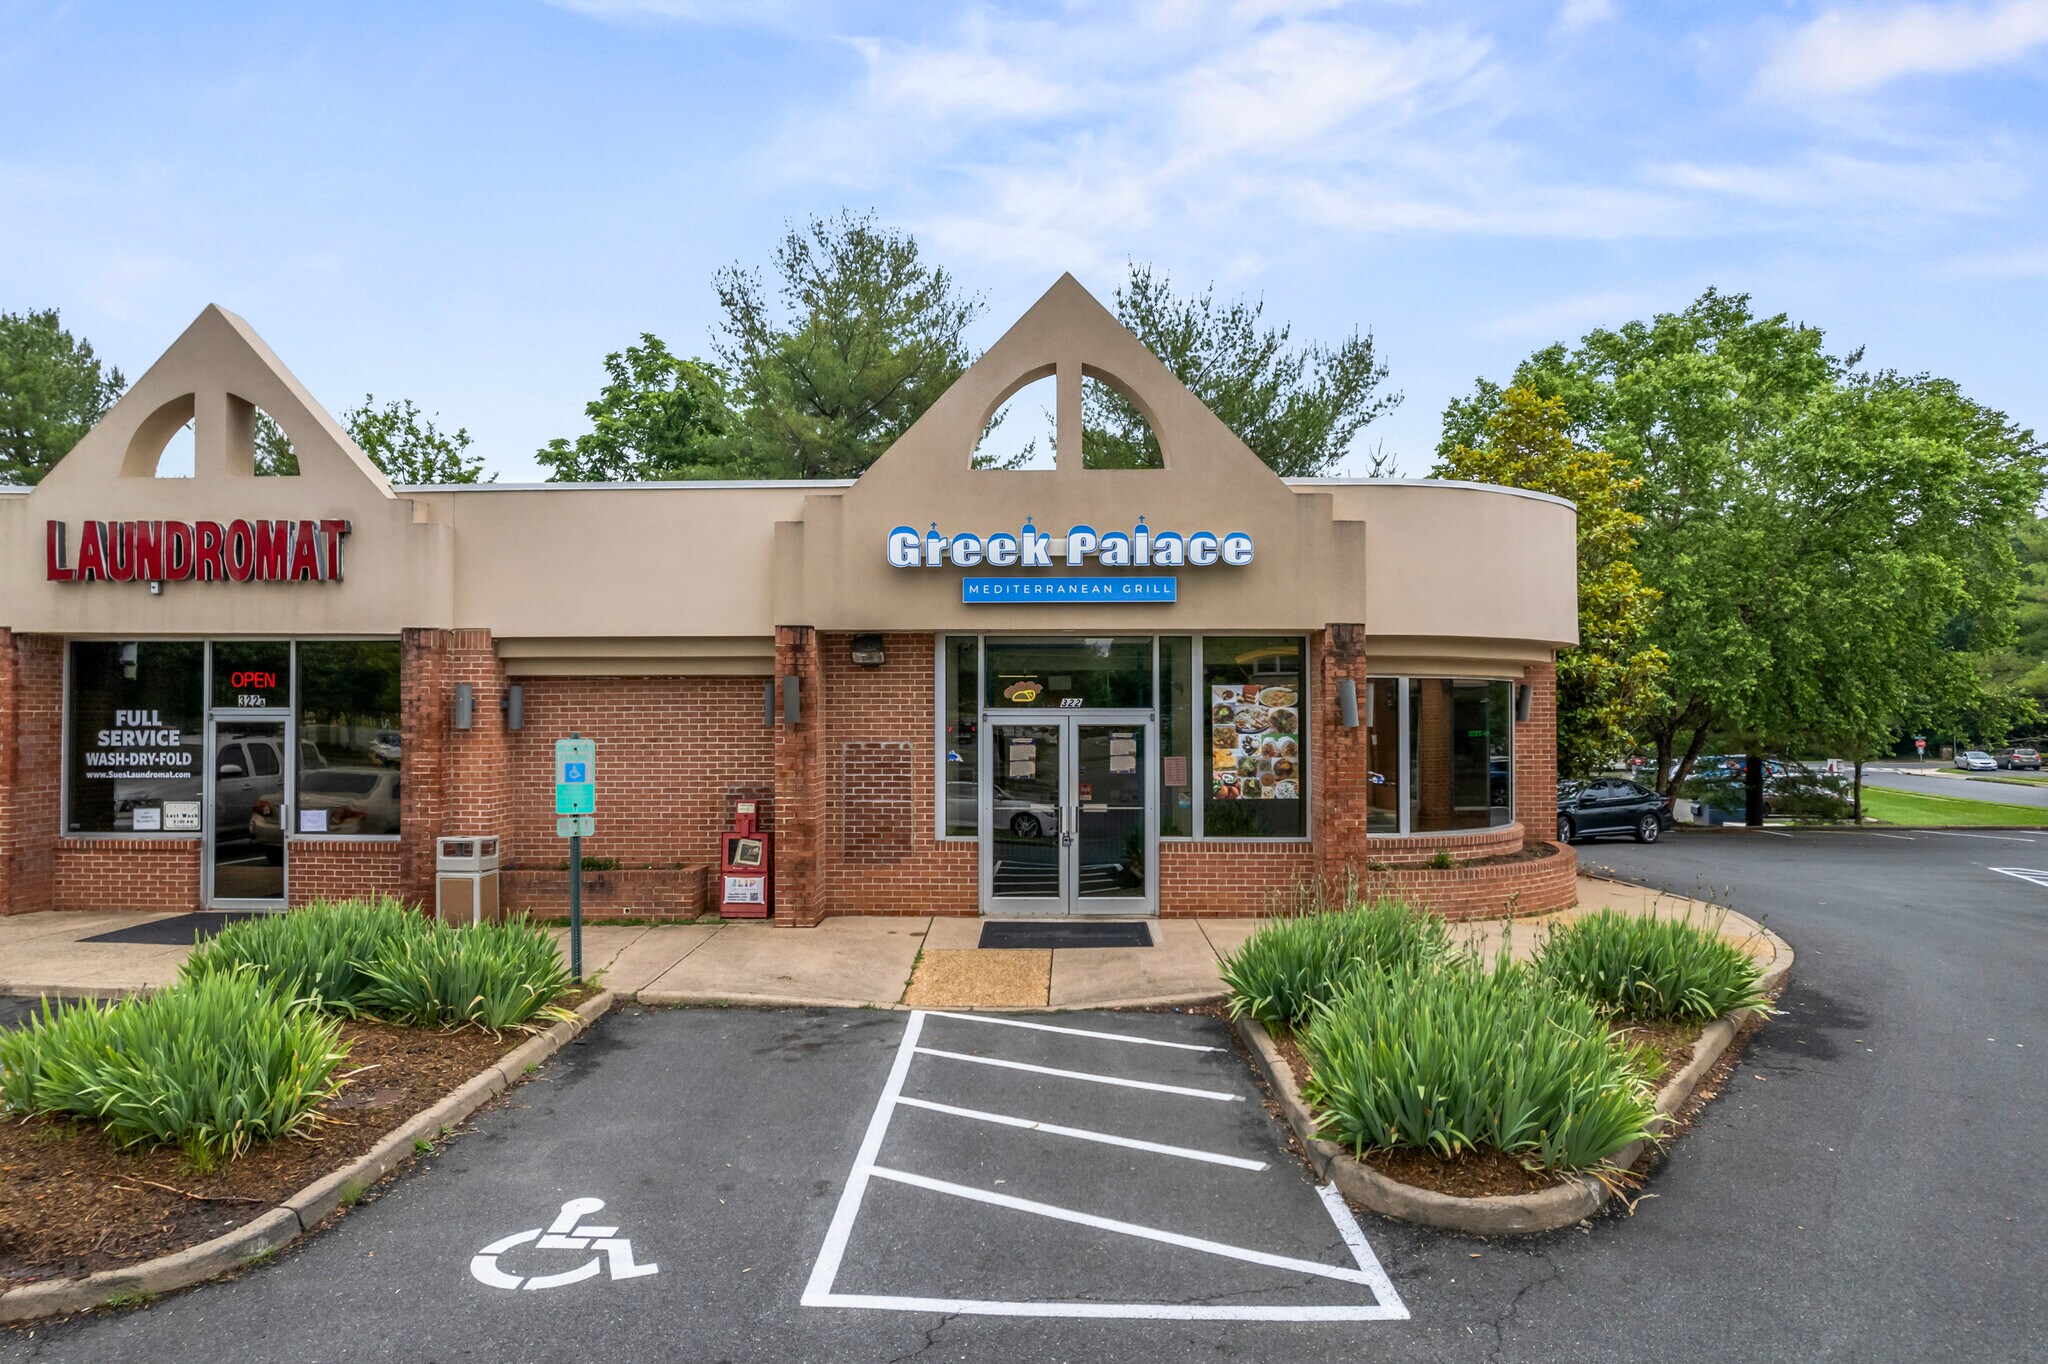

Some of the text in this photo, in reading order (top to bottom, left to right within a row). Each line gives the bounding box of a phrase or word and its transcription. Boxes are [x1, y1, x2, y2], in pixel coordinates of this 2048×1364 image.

[46, 519, 351, 582] LAUNDROMAT
[887, 522, 1254, 567] Greek Palace
[969, 584, 1171, 594] MEDITERRANEAN GRILL
[231, 671, 276, 688] OPEN
[1061, 698, 1082, 707] 322
[116, 709, 162, 727] FULL
[98, 730, 180, 747] SERVICE
[85, 752, 192, 767] WASH-DRY-FOLD
[86, 770, 191, 779] www.SuesLaundromat.com
